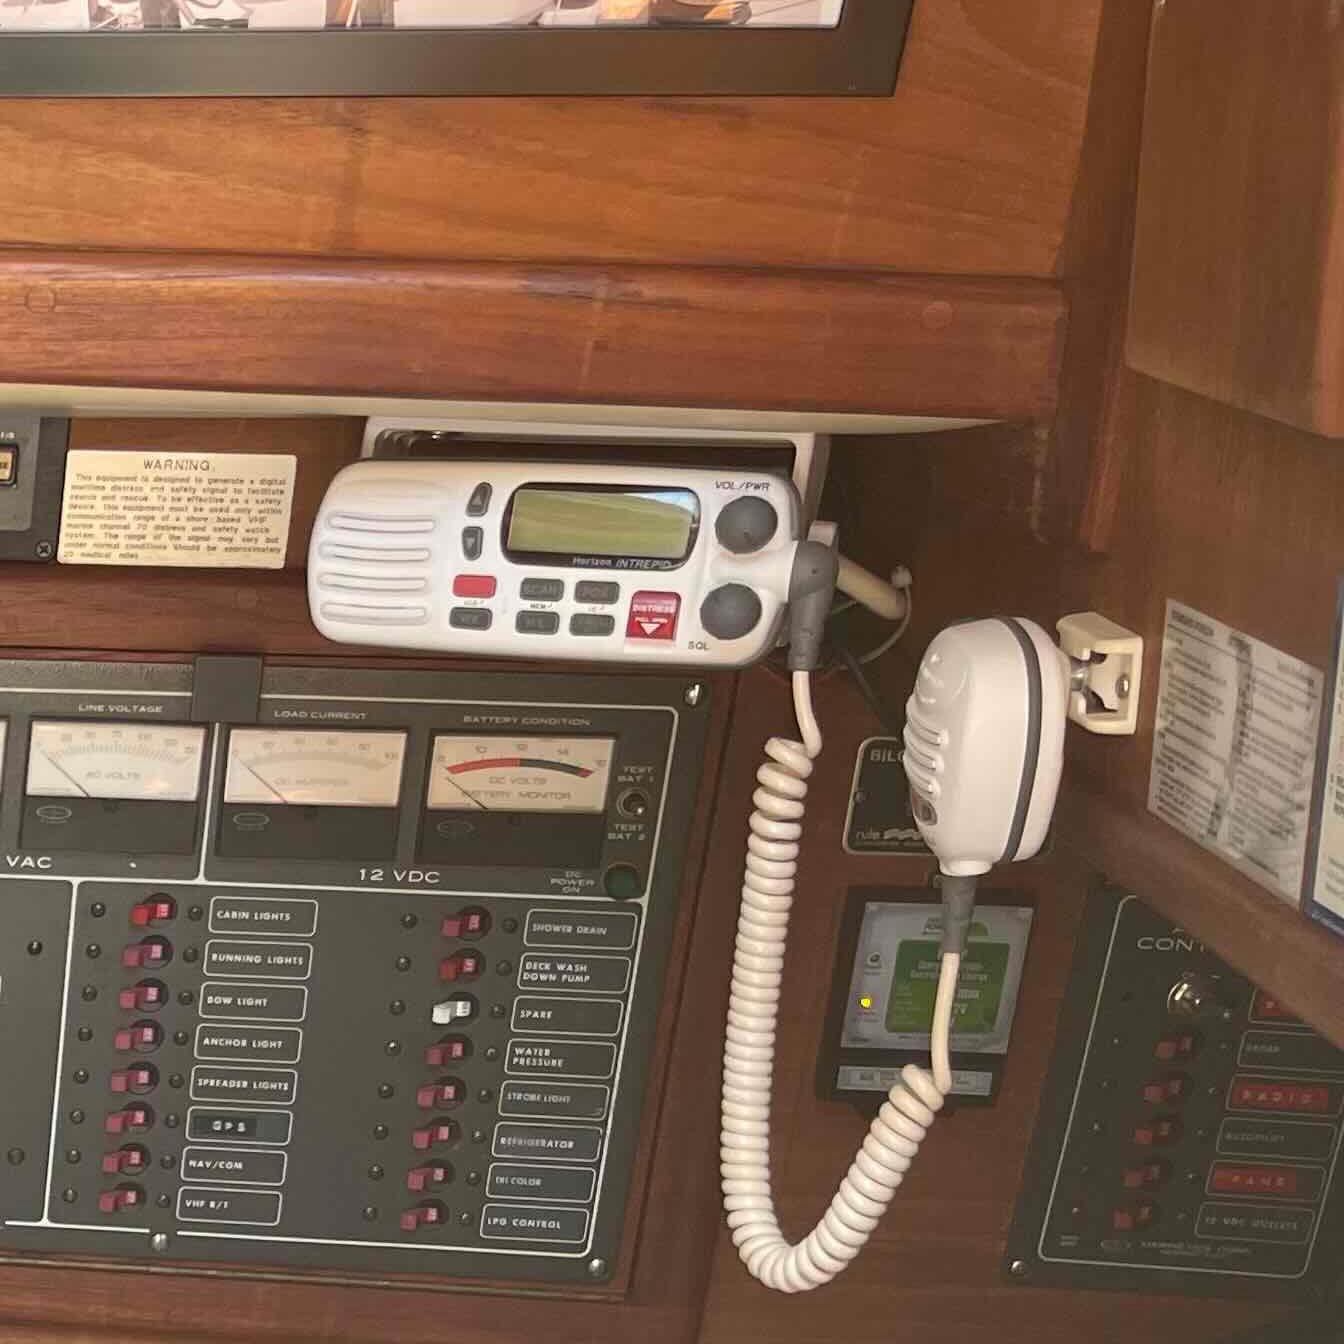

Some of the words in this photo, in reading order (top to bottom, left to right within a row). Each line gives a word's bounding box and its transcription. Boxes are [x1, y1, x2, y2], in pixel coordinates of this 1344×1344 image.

[144, 459, 211, 472] WARNING
[714, 480, 771, 492] VOL/PWR
[615, 558, 673, 569] INTREPID
[688, 640, 710, 651] SQL
[78, 704, 105, 713] LINE
[106, 705, 164, 714] VOLTAGE
[274, 710, 308, 719] LOAD
[310, 711, 367, 721] CURRENT
[463, 715, 519, 726] BATTERY
[521, 716, 592, 727] CONDITION
[617, 774, 643, 783] BAT
[518, 790, 572, 801] MONITOR
[607, 832, 633, 841] BAT
[5, 854, 53, 870] VAC
[358, 868, 384, 883] 12
[391, 869, 442, 885] VDC
[550, 878, 596, 888] POWER
[216, 910, 251, 921] CABIN
[254, 911, 292, 922] LIGHTS
[531, 924, 573, 935] SHOWER
[575, 925, 609, 937] DRAIN
[1136, 935, 1206, 952] CON
[211, 953, 263, 965] RUNNING
[267, 956, 305, 966] LIGHTS
[525, 961, 553, 972] DECK
[556, 962, 588, 974] WASH
[522, 971, 557, 983] DOWN
[560, 973, 591, 984] PUMP
[207, 996, 233, 1007] BOW
[237, 998, 269, 1008] LIGHT
[520, 1009, 553, 1020] SPARE
[202, 1038, 248, 1049] ANCHOR
[251, 1039, 284, 1050] LIGHT
[514, 1046, 552, 1058] WATER
[512, 1056, 565, 1068] PRESSURE
[197, 1078, 249, 1090] SPREADER
[252, 1080, 290, 1092] LIGHTS
[507, 1091, 542, 1103] STROBE
[500, 1137, 575, 1150] REFRIGERATOR
[189, 1159, 244, 1171] NAV/COM
[185, 1199, 207, 1209] VHF
[511, 1218, 562, 1231] CONTROL
